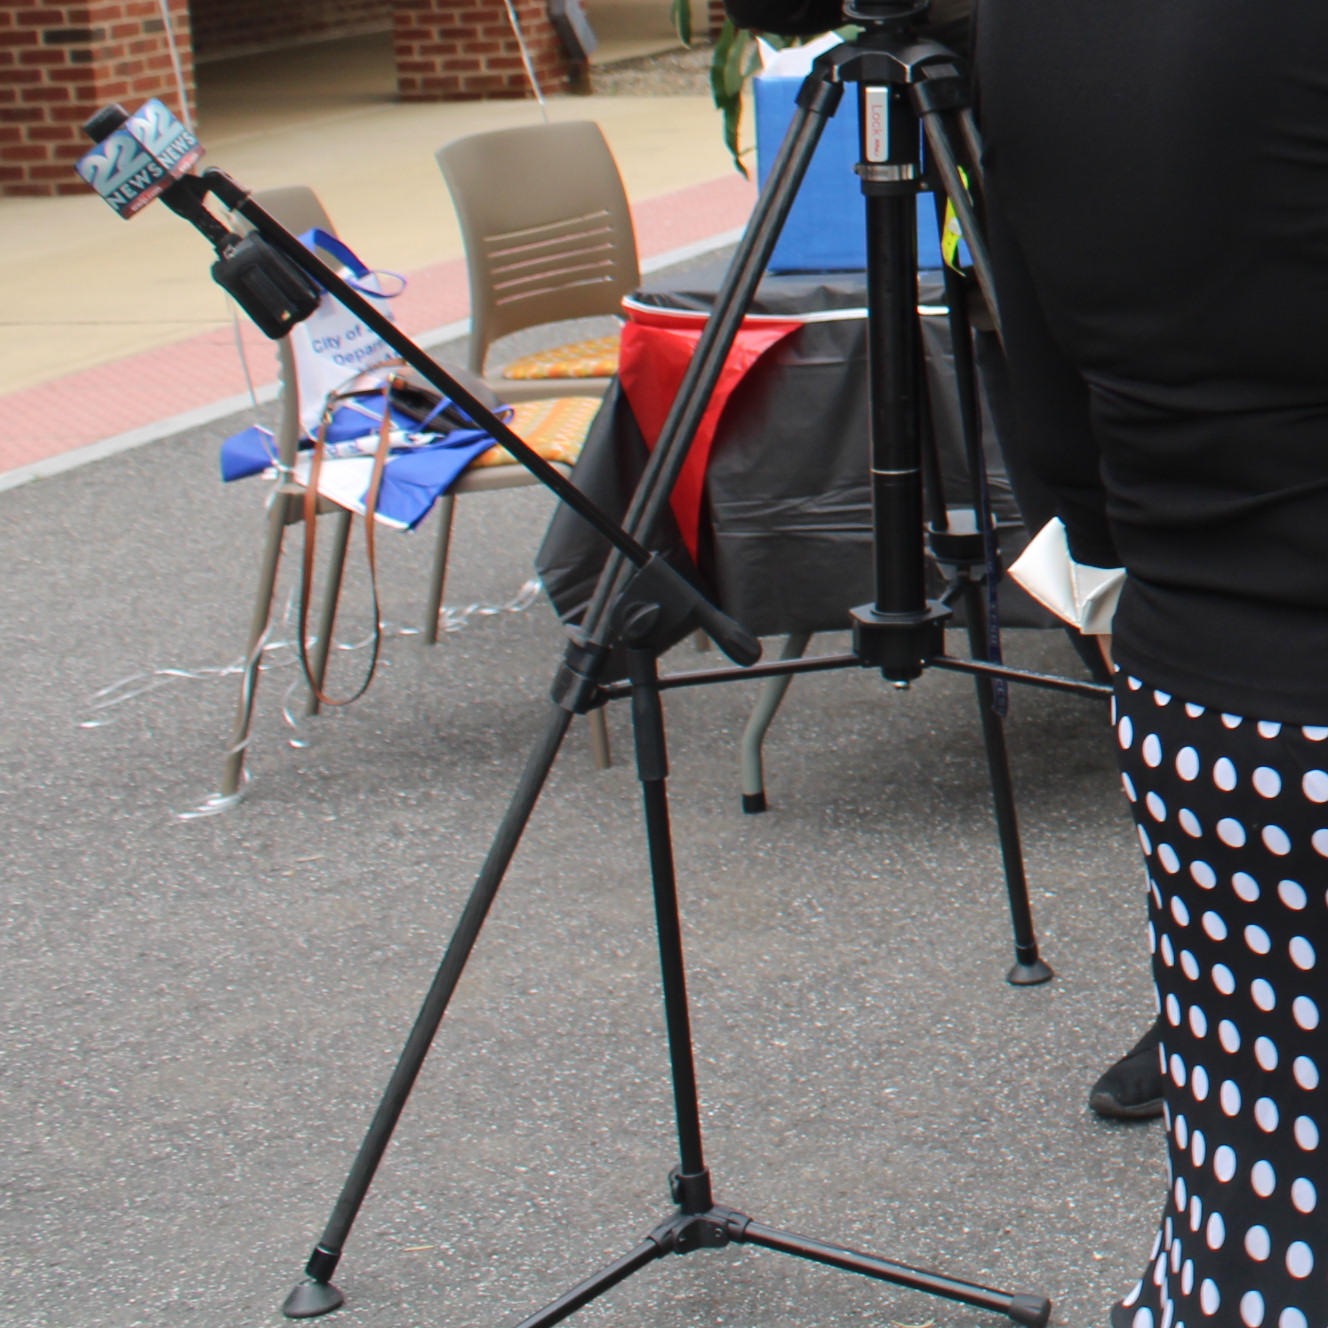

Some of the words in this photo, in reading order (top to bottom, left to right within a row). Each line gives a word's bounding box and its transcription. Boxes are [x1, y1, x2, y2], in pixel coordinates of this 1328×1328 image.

[130, 101, 185, 156] 22
[872, 104, 883, 136] Lock
[81, 134, 152, 196] 22
[158, 131, 197, 170] NEWS
[106, 162, 163, 210] NEWS
[311, 334, 341, 354] City
[345, 324, 363, 341] of
